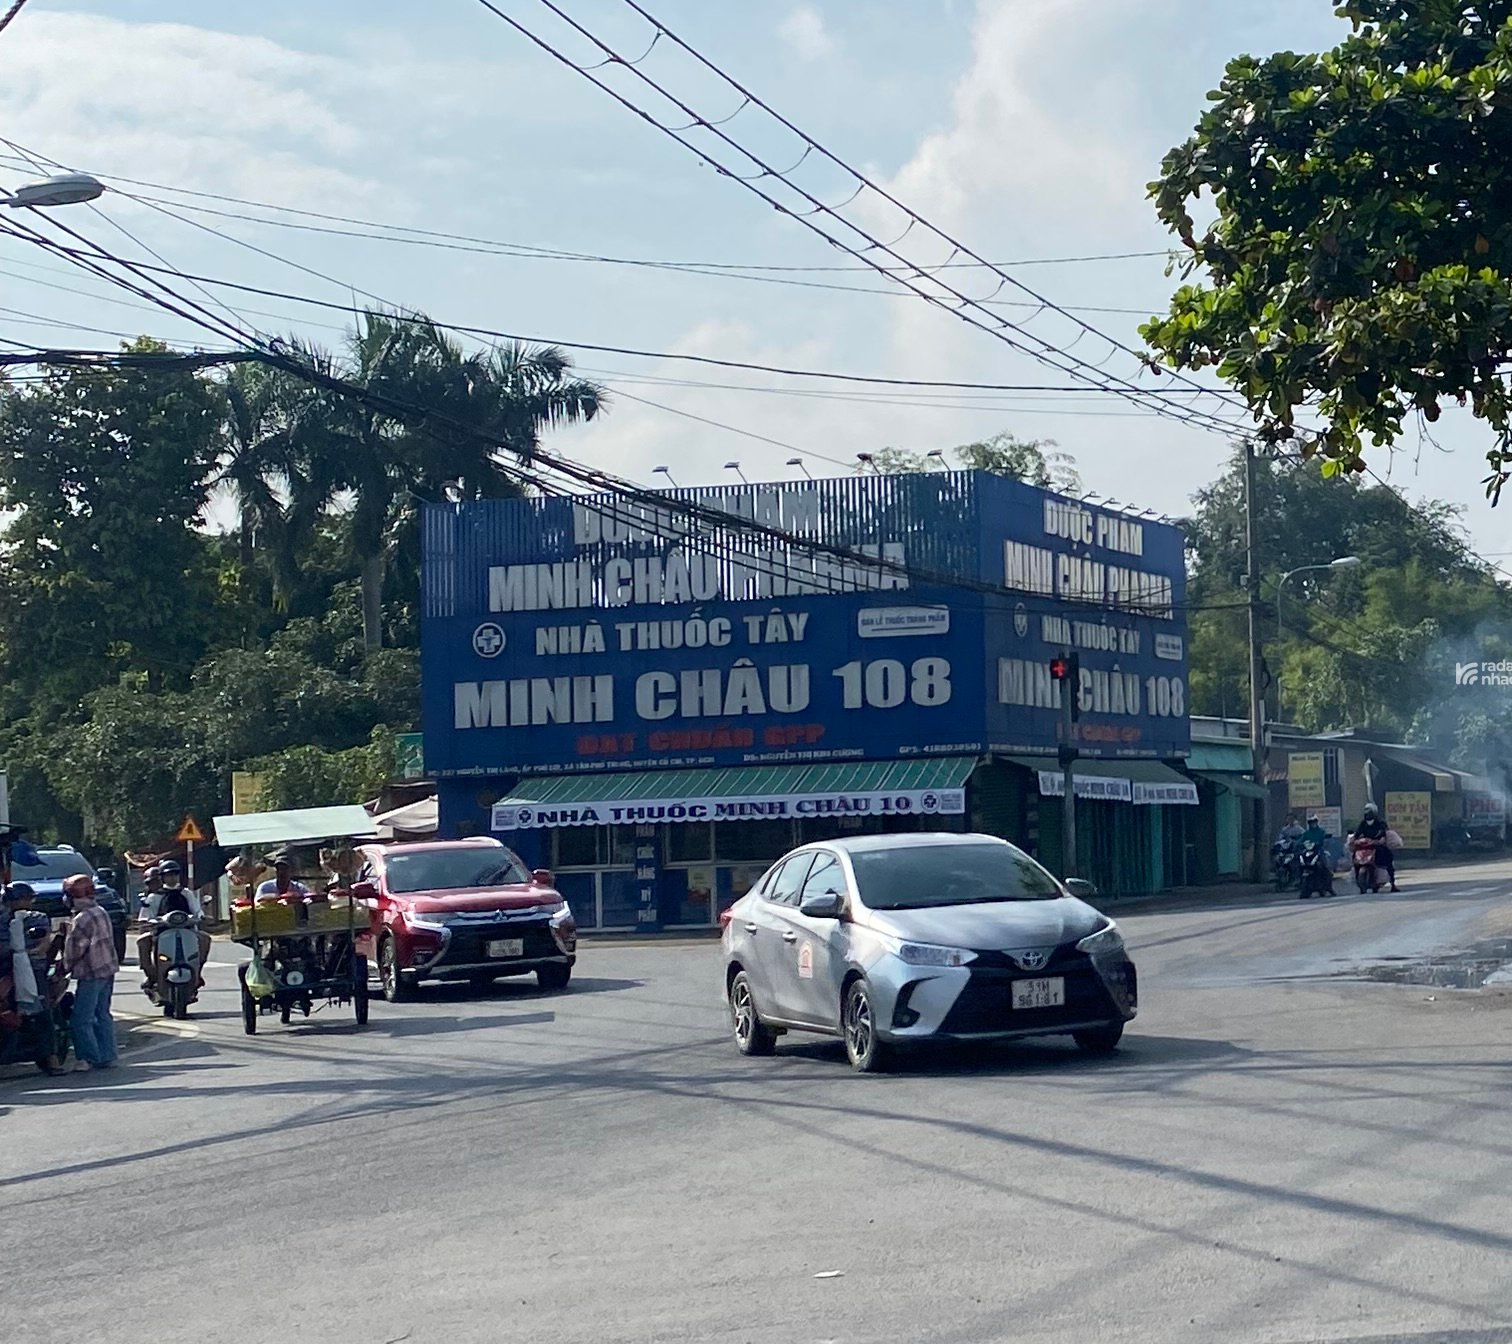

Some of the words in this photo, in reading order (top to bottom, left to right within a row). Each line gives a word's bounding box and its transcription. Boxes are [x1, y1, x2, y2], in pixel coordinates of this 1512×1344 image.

[1044, 499, 1094, 551] DƯỢC
[489, 561, 592, 613] MINH
[604, 546, 719, 607] CHÂU
[1004, 539, 1054, 595] MINH
[1057, 552, 1105, 604] CHÂU
[535, 618, 606, 656] NHÀ
[615, 606, 732, 653] THUỐC
[743, 607, 810, 644] TÂY
[1072, 617, 1118, 652] THUỐC
[1119, 623, 1141, 655] TÂY
[454, 673, 614, 730] MINH
[635, 657, 810, 721] CHÂU
[832, 656, 952, 710] 108
[1078, 664, 1140, 716] CHÂU
[1146, 675, 1185, 718] 108
[536, 806, 600, 824] NHÀ
[609, 801, 708, 822] THUỐC
[714, 801, 788, 817] MINH
[796, 795, 871, 814] CHÂU
